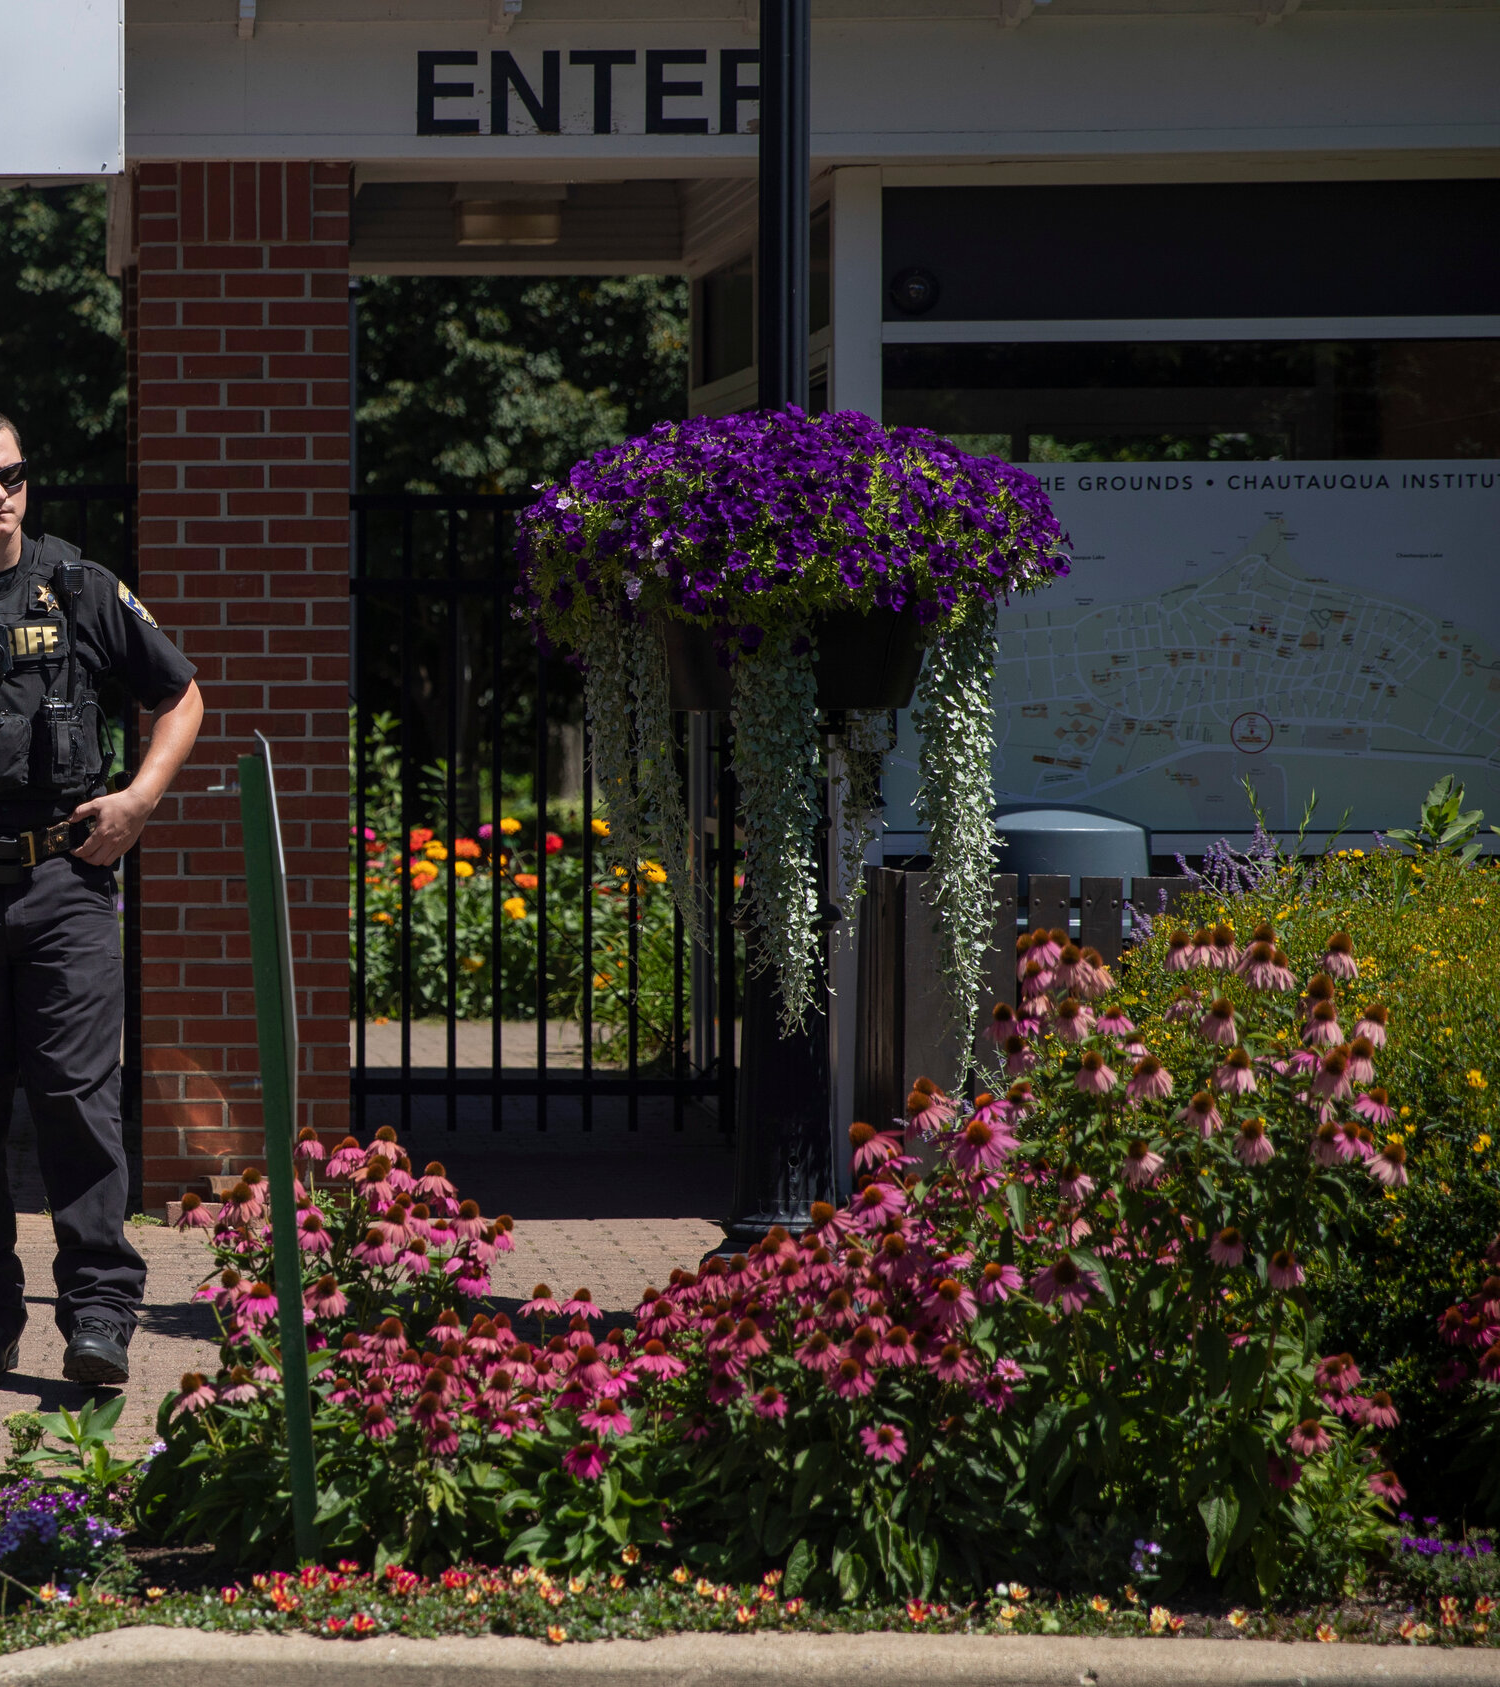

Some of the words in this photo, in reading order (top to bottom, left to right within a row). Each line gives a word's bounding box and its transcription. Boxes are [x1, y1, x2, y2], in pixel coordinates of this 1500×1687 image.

[1077, 475, 1193, 491] GROUNDS
[1227, 473, 1390, 490] CHAUTAUQUA
[1402, 473, 1500, 489] INSTITU
